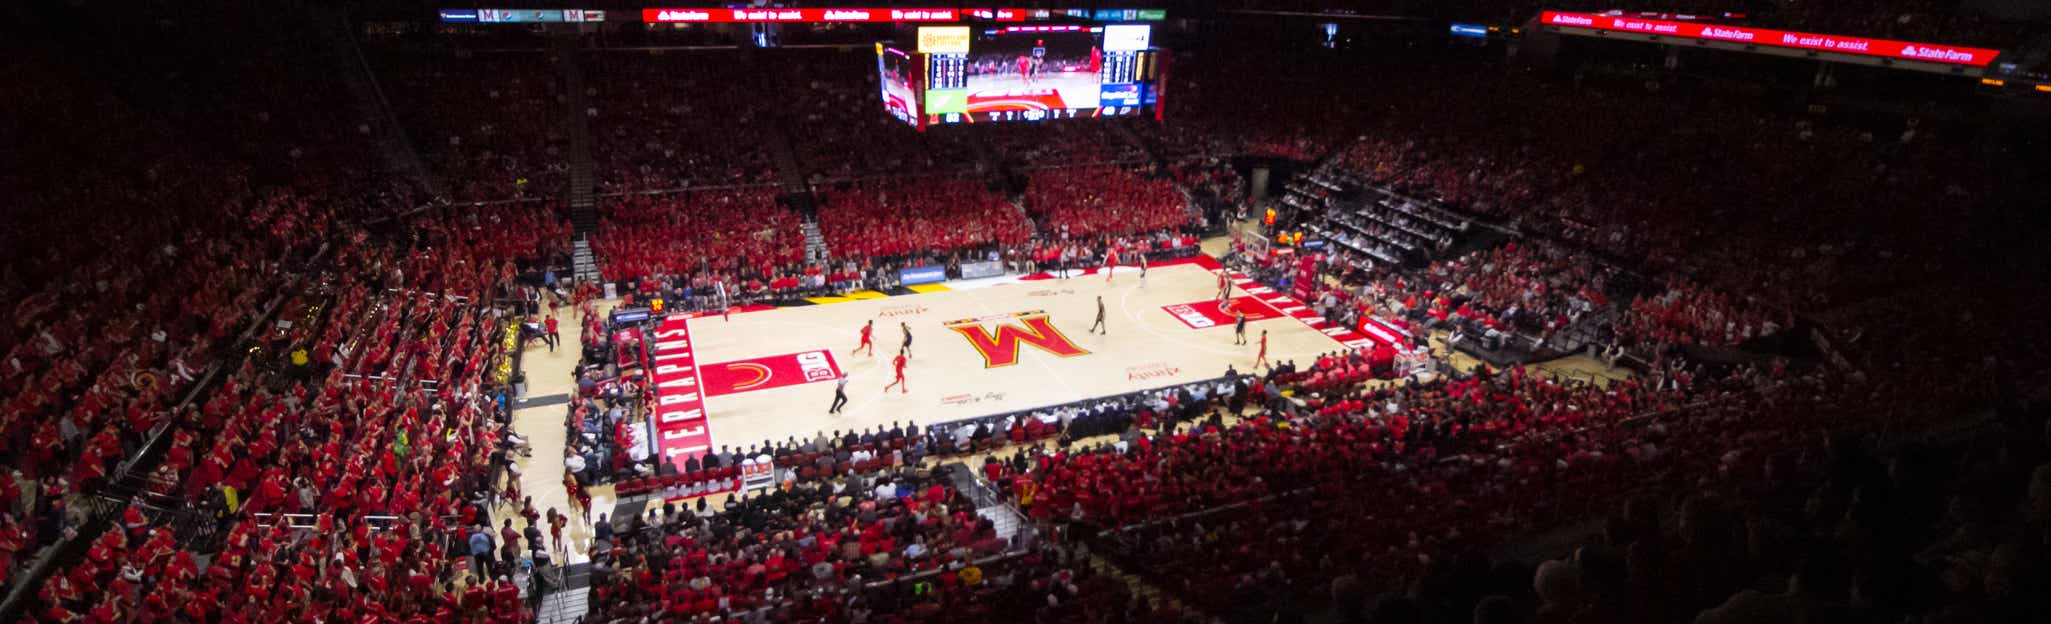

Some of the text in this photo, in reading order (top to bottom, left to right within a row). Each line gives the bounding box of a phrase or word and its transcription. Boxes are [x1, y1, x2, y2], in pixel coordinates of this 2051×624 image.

[1783, 33, 1798, 44] We
[1799, 36, 1824, 47] exist
[1824, 38, 1836, 48] to
[654, 328, 709, 458] TERRAPINS
